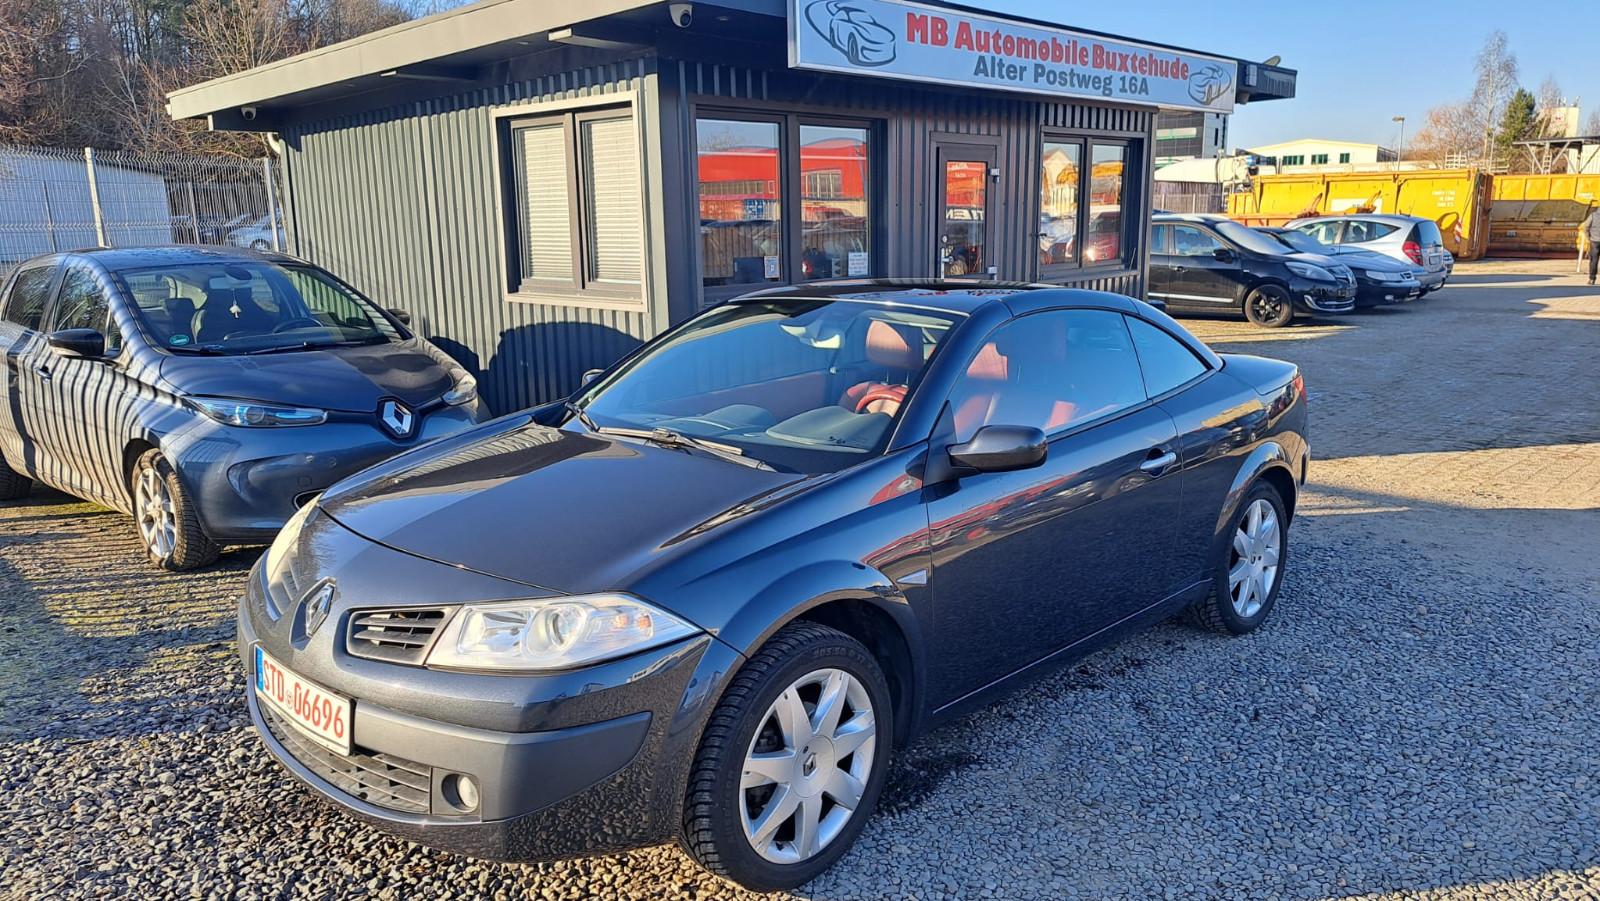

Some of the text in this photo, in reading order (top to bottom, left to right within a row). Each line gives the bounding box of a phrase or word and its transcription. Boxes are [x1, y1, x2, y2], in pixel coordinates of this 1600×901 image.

[906, 12, 1190, 81] MB Automobile Buxtehude
[973, 55, 1150, 97] Alter Postweg 16A
[263, 659, 345, 738] STD 06696
